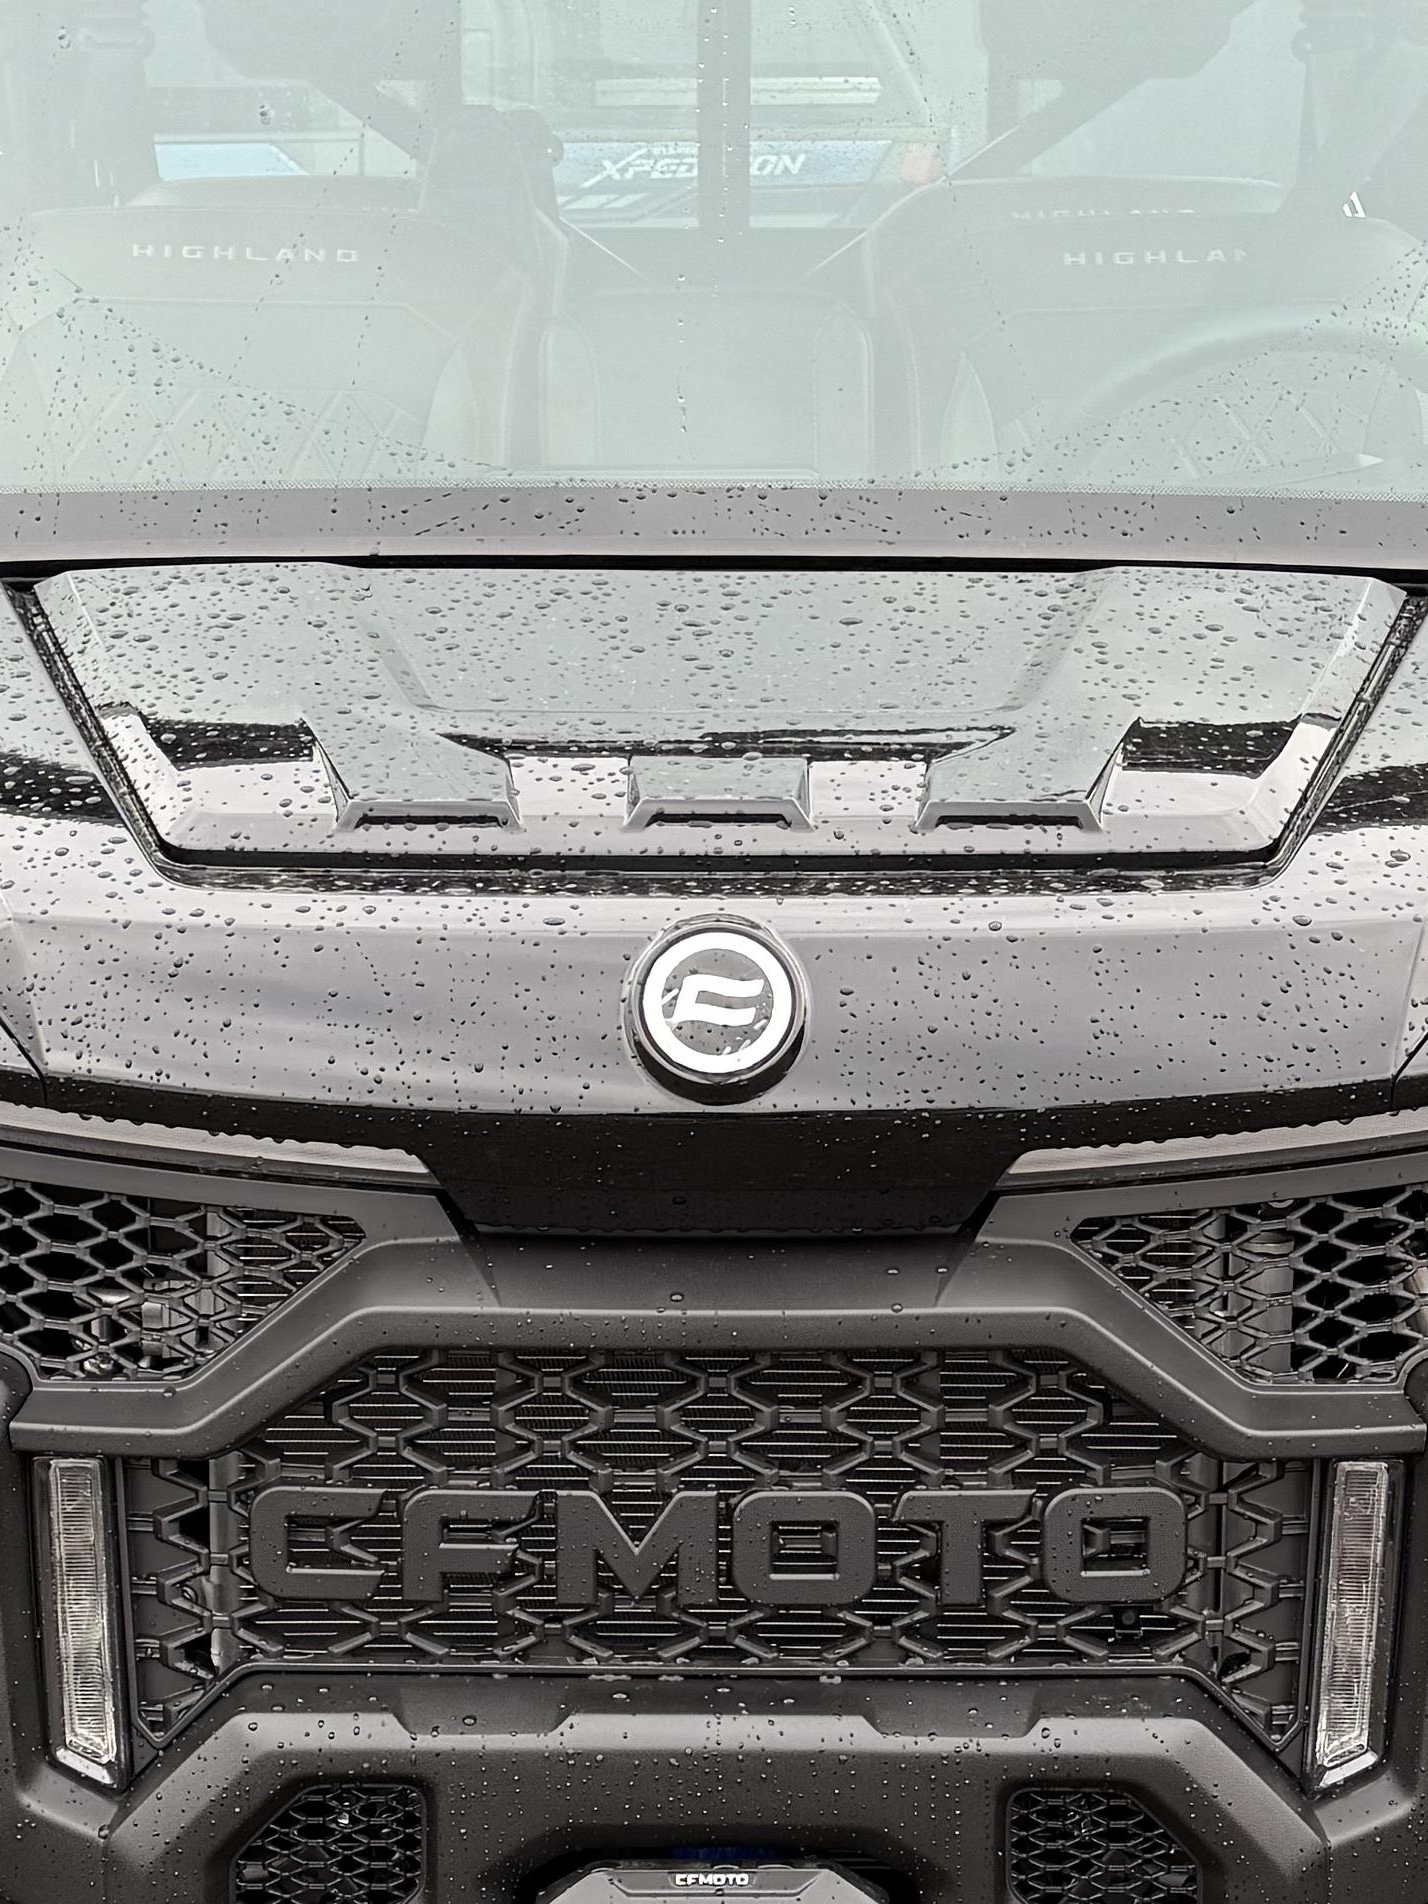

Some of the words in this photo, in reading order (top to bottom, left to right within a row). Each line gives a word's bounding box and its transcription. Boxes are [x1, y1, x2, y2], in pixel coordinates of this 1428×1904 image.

[131, 244, 360, 264] HIGHLAND
[248, 1486, 1187, 1609] CFMOTO
[674, 1872, 750, 1887] CFMOTO
